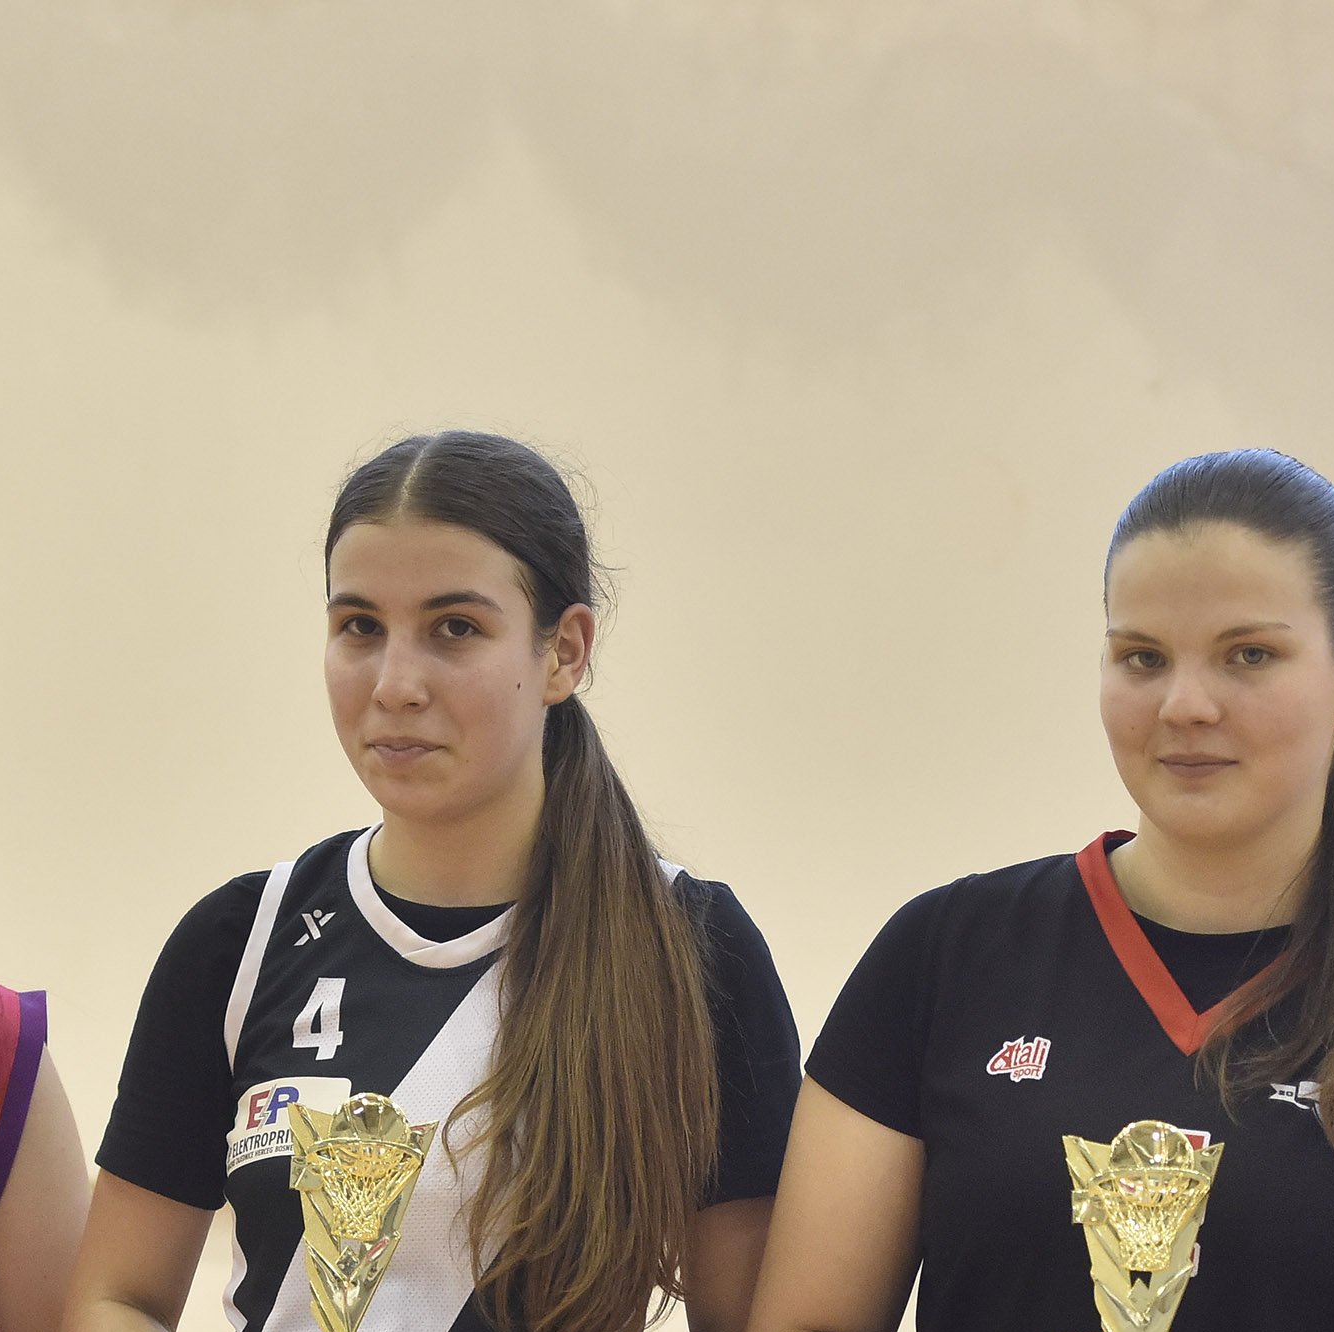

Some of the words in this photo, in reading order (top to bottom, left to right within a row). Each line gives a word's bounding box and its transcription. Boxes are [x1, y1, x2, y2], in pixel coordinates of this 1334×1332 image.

[292, 977, 346, 1060] 4
[989, 1039, 1048, 1072] Atali
[1012, 1068, 1040, 1080] sport
[233, 1129, 291, 1159] ELEKTROPRI
